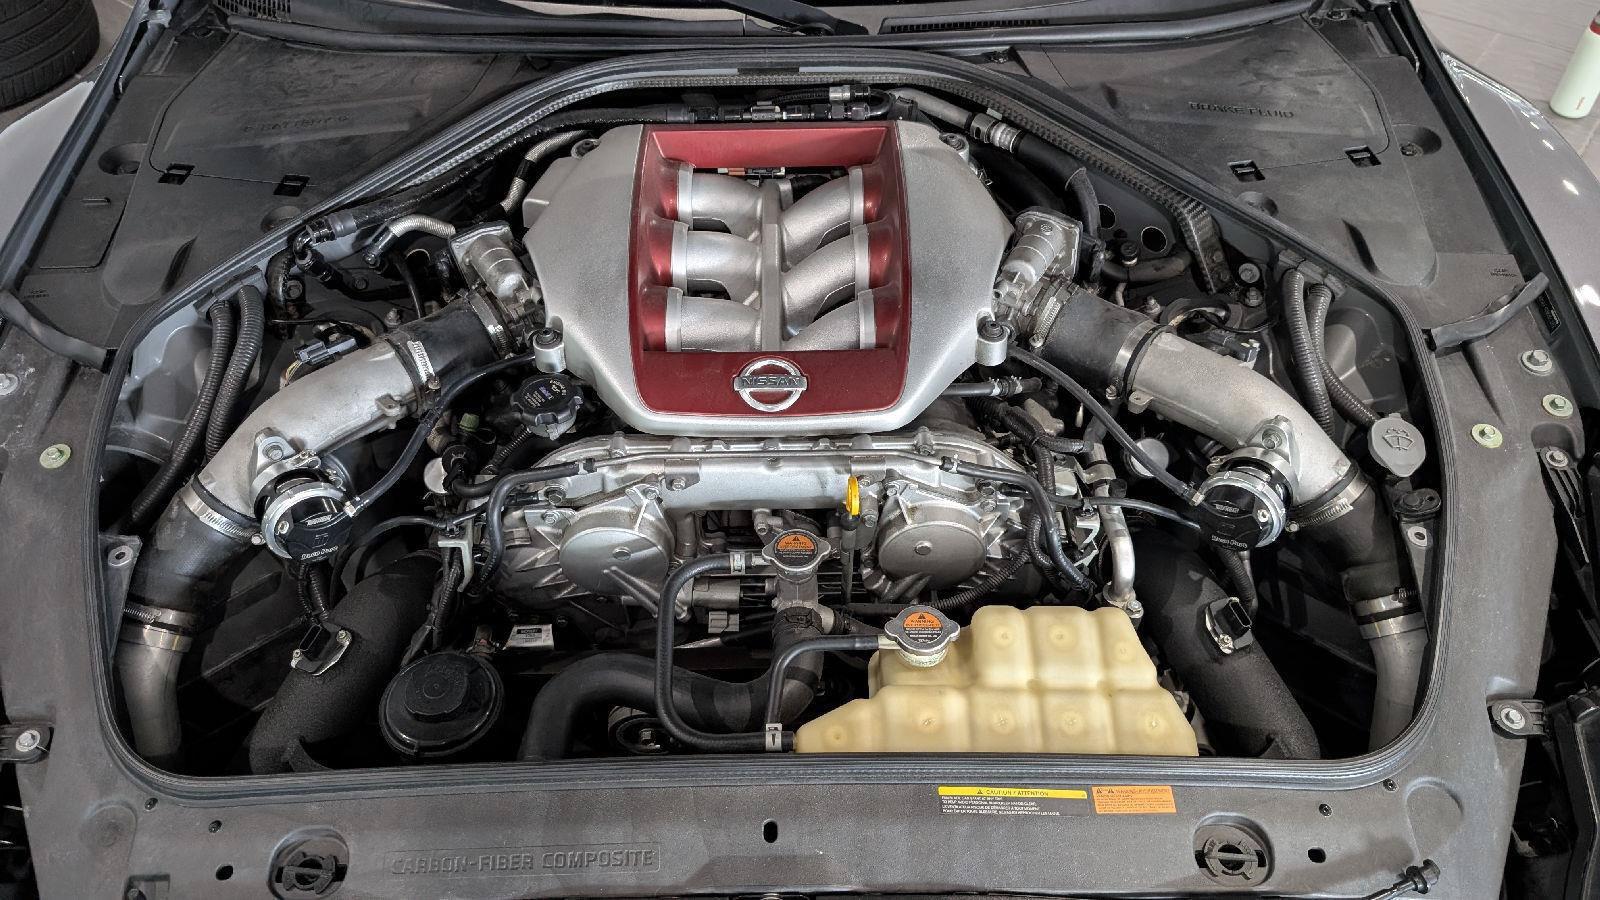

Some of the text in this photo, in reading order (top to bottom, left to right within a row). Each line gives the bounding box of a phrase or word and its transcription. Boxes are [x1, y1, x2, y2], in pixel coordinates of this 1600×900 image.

[1188, 102, 1294, 118] BRAKE FLUID
[742, 376, 800, 386] NISSAN
[392, 850, 653, 875] CARBON-FIBER COMPOSITE
